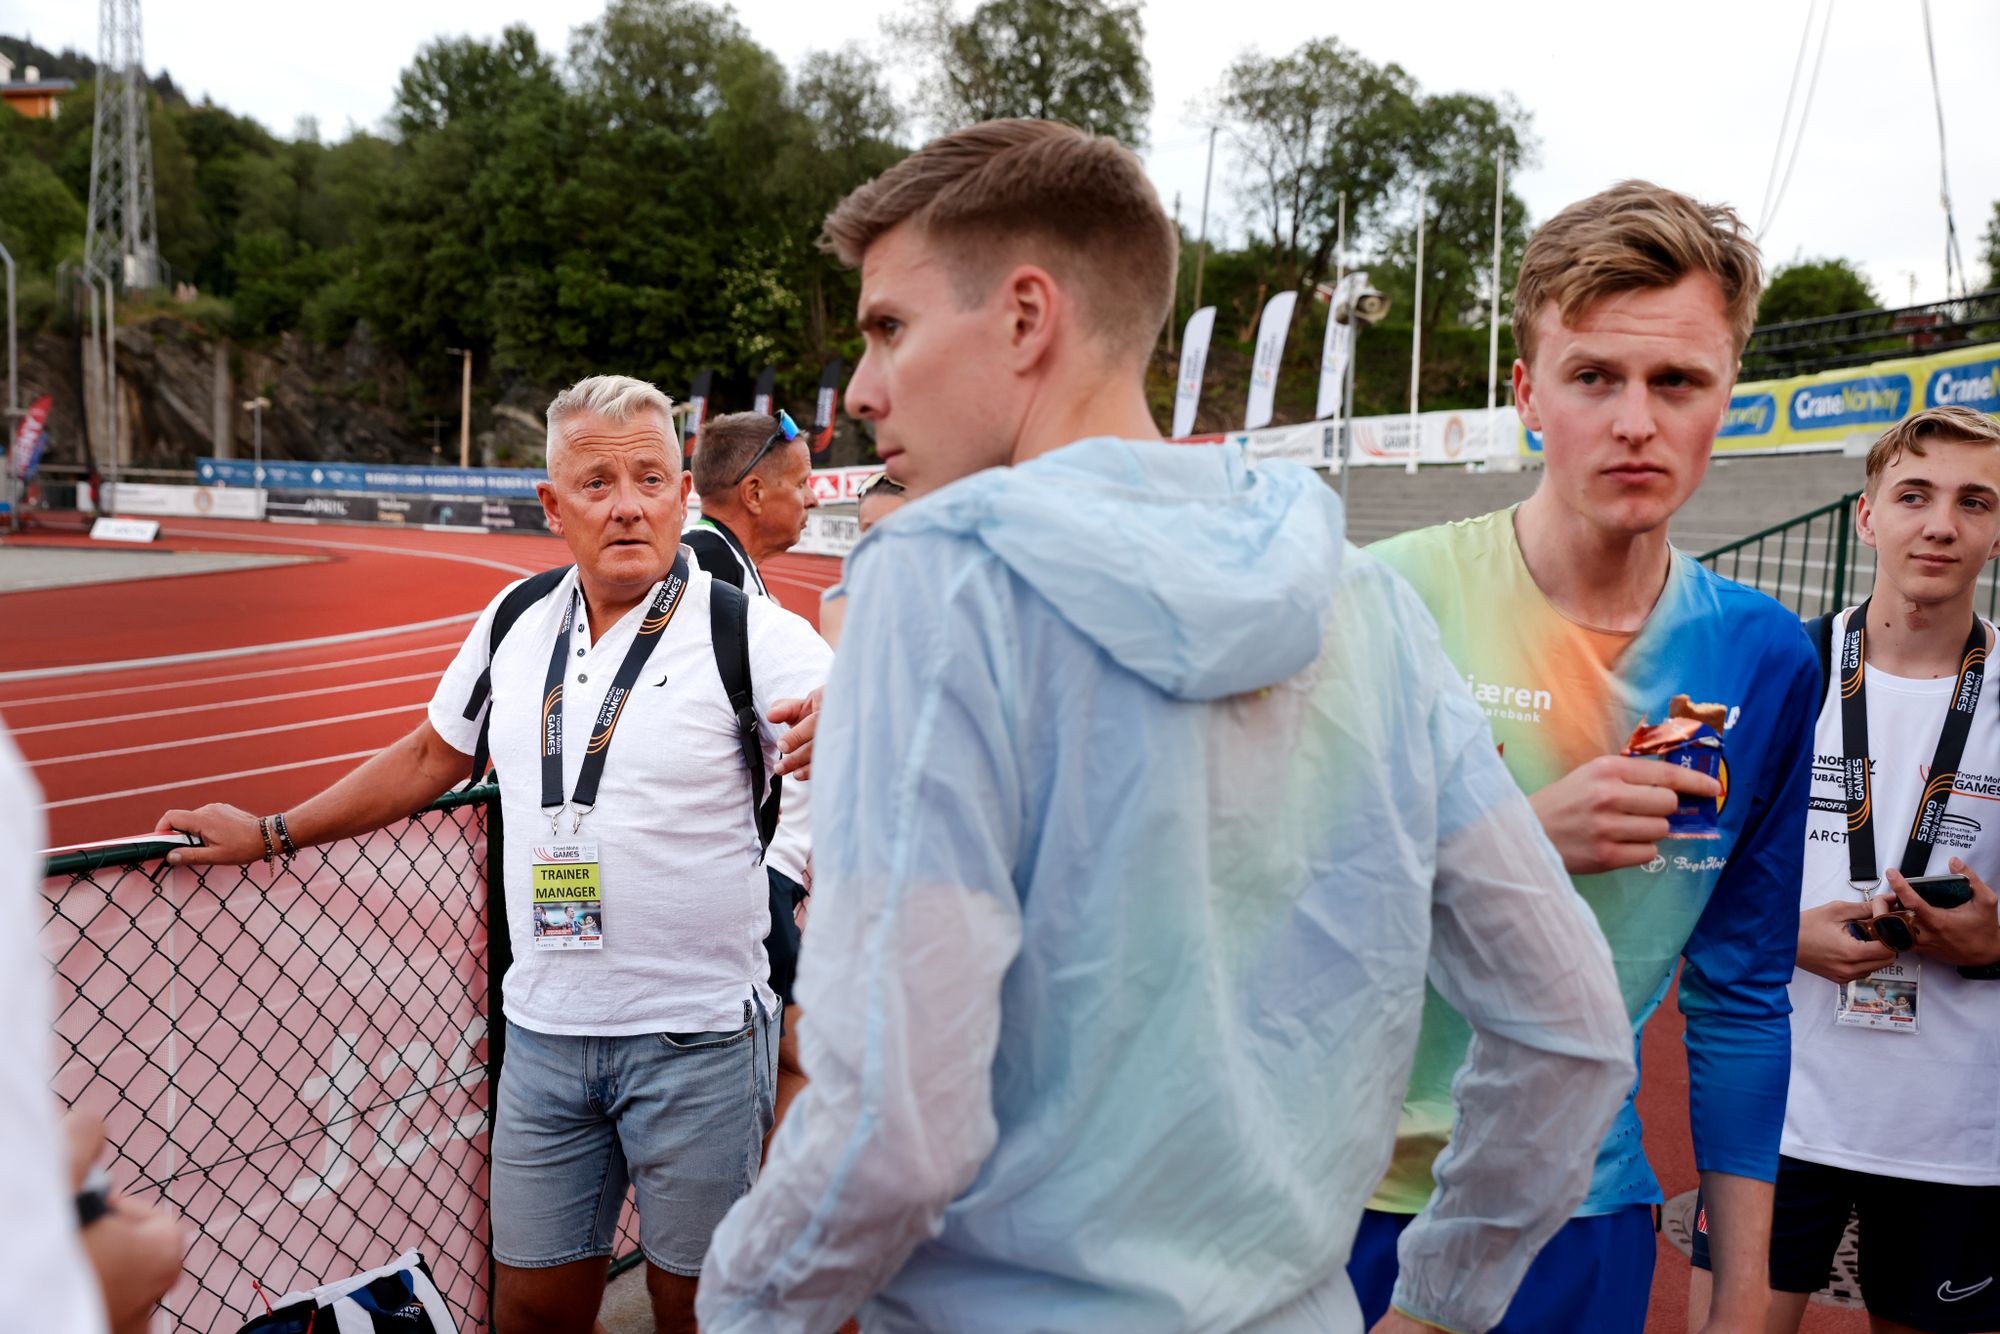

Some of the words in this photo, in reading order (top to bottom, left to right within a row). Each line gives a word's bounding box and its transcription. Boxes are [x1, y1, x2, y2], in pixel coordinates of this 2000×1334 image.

[652, 590, 665, 608] Trond
[663, 573, 674, 590] Mohn
[660, 577, 682, 613] GAMES
[1849, 630, 1860, 669] GAMES
[1957, 671, 1975, 711] GAMES
[1972, 674, 1983, 694] Trond
[597, 705, 607, 724] Trond
[605, 686, 616, 704] Mohn
[603, 687, 625, 727] GAMES
[1967, 694, 1978, 714] Mohn
[547, 714, 556, 756] GAMES
[1818, 754, 1876, 769] NORY
[1852, 758, 1864, 801] GAMES
[1957, 771, 1982, 781] Trond
[1917, 800, 1937, 842] GAMES
[1808, 829, 1848, 844] ARCT
[1936, 830, 1976, 842] ontinental
[1949, 839, 1972, 849] Silver
[541, 868, 590, 880] TRAINER
[535, 886, 596, 899] MANAGER
